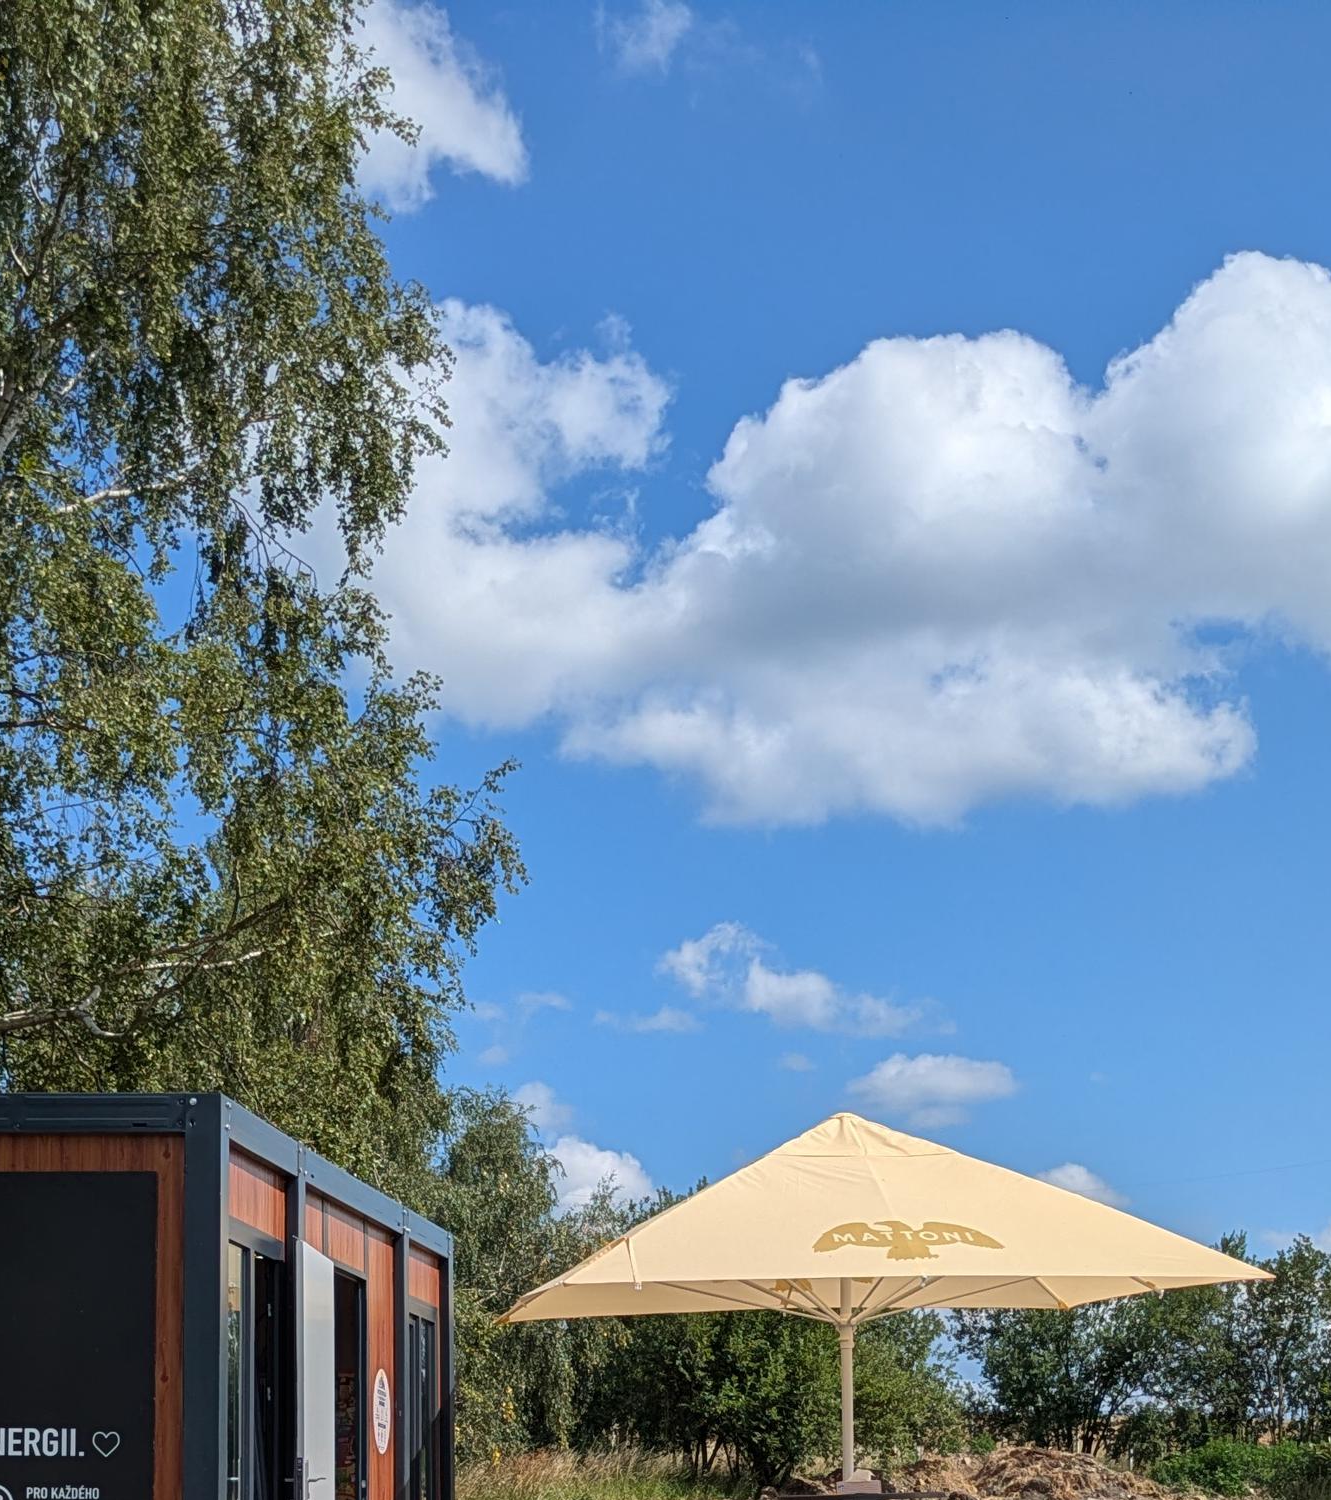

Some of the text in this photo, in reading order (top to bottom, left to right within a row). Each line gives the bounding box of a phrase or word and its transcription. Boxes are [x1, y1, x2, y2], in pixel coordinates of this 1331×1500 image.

[833, 1230, 975, 1243] MATTONI
[26, 1485, 99, 1499] PRO KAŽDÉHO
